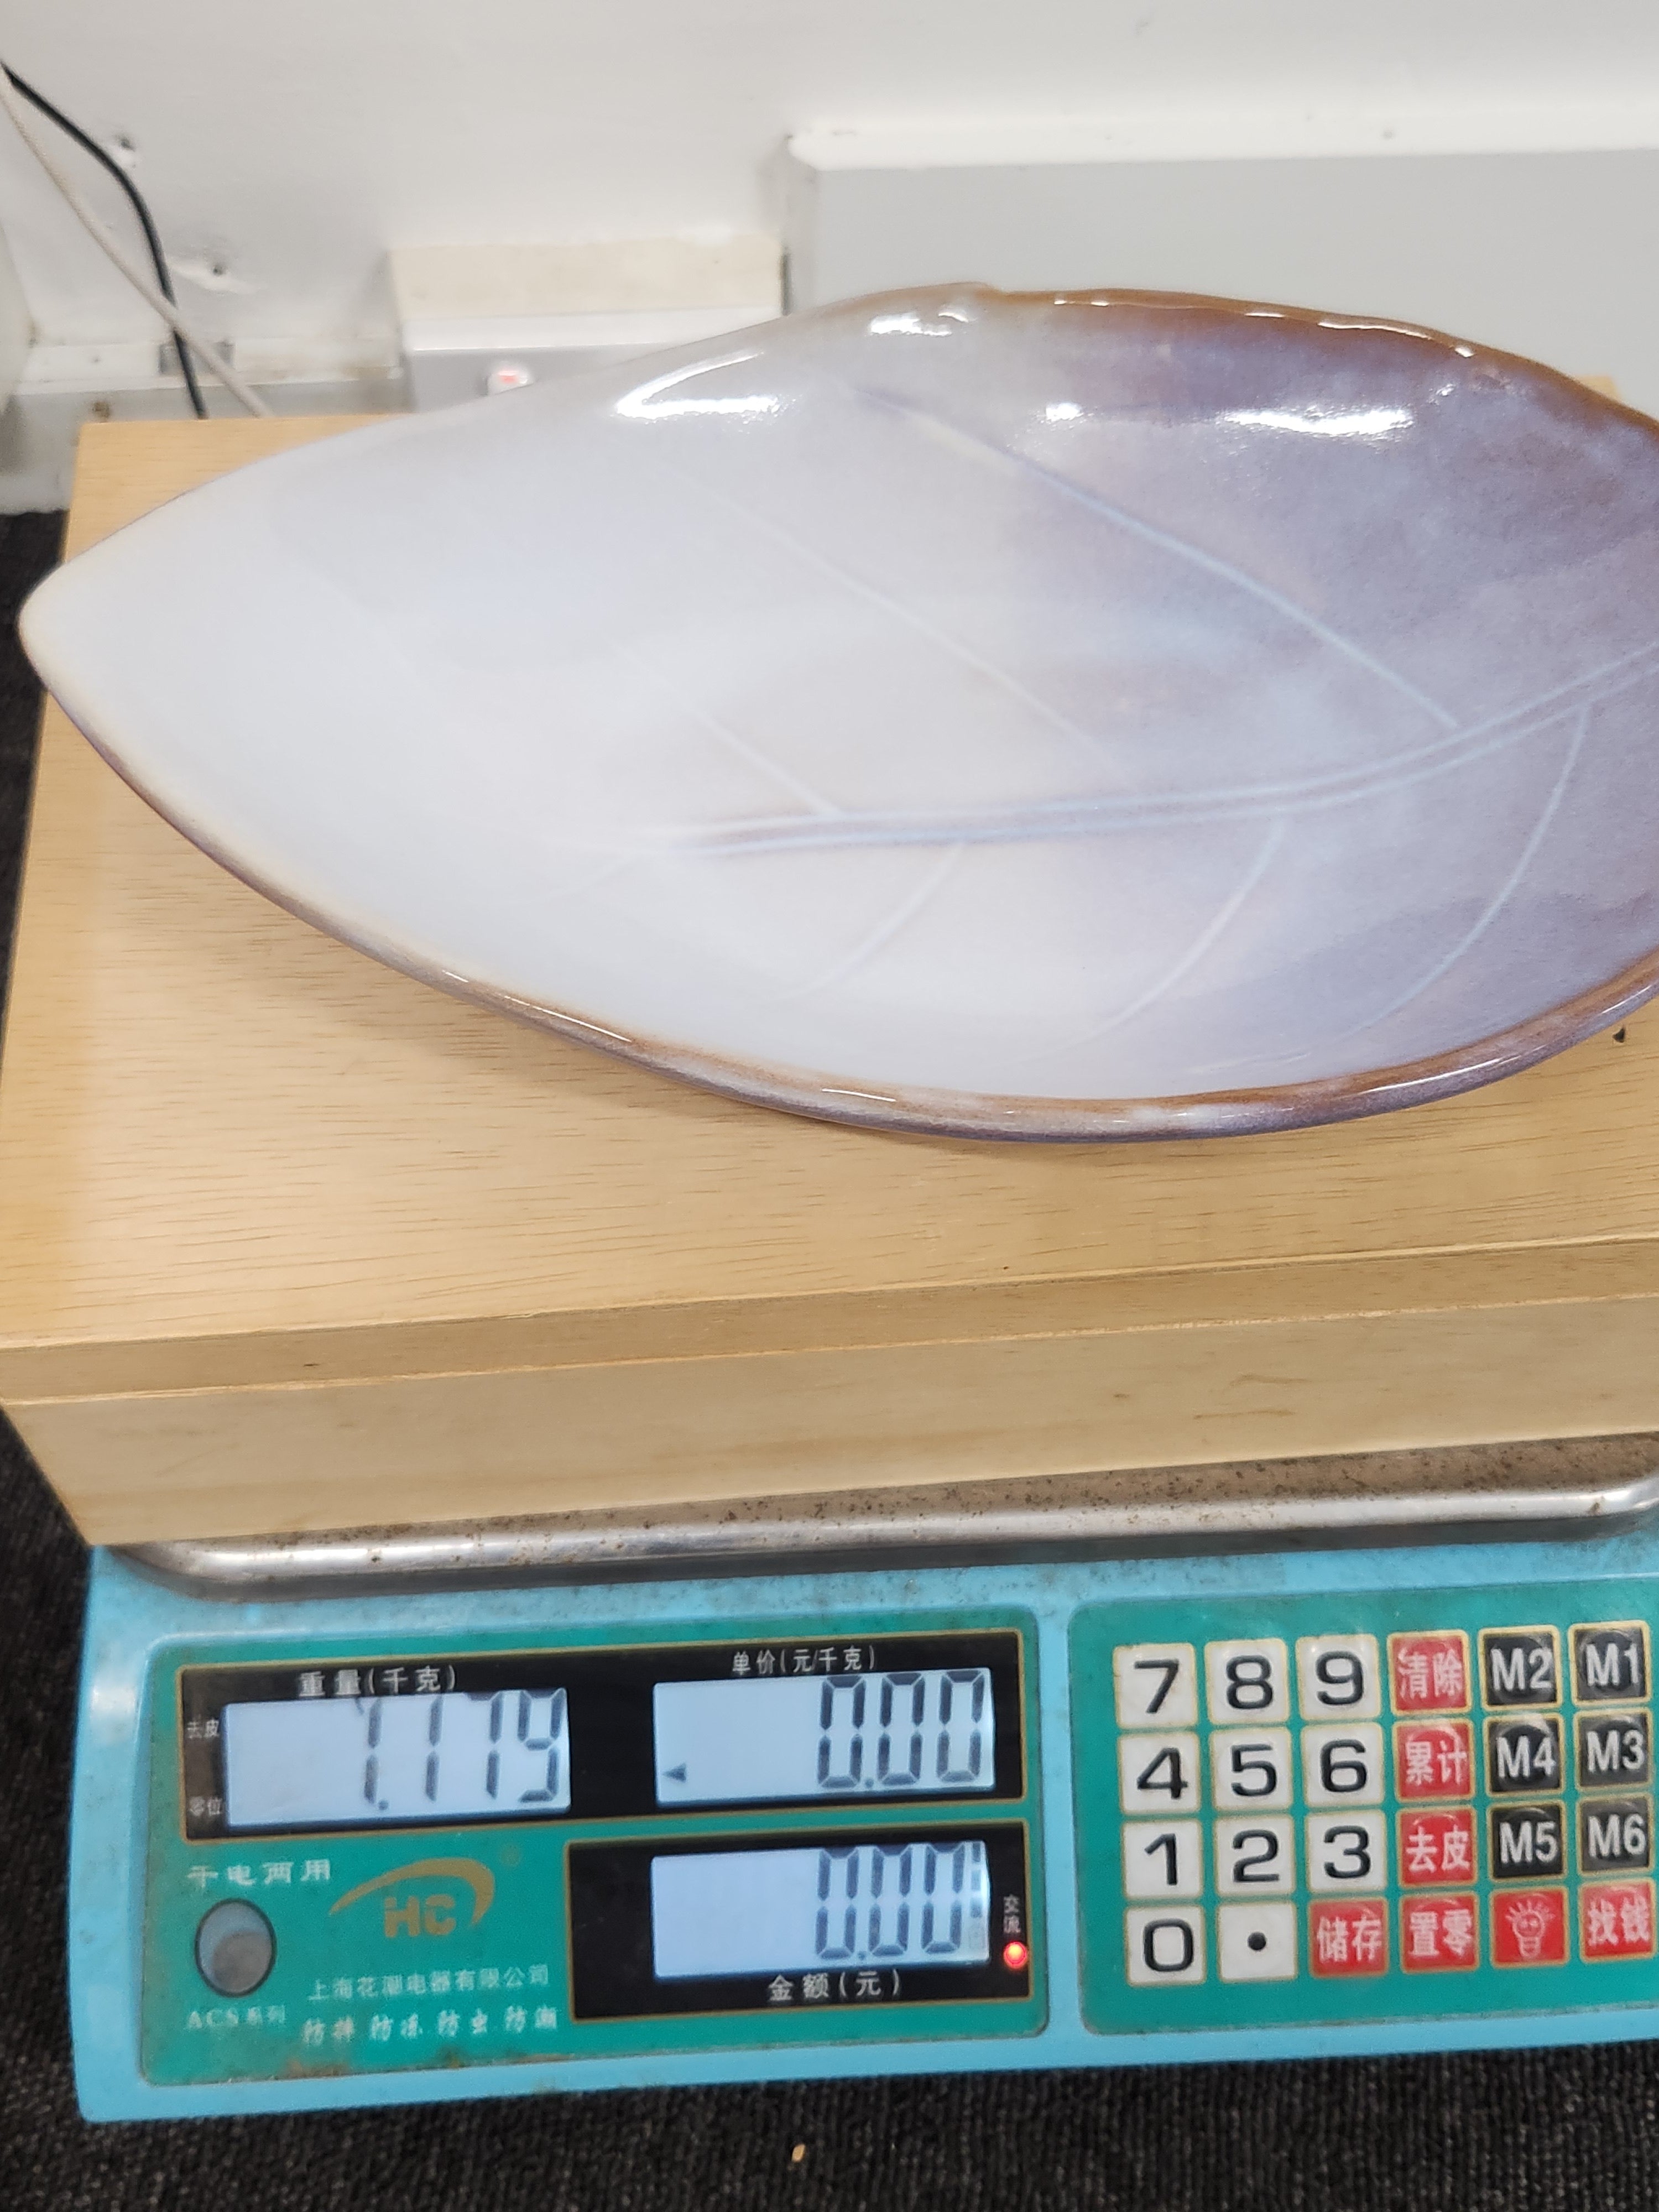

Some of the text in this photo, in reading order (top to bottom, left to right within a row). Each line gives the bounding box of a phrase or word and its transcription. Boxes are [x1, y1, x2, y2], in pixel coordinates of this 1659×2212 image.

[1134, 1658, 1179, 1714] 7
[1226, 1655, 1274, 1710] 8
[1315, 1651, 1365, 1705] 9
[1397, 1647, 1463, 1700] 清除
[1491, 1646, 1553, 1692] M2
[1585, 1642, 1640, 1687] M1
[1137, 1747, 1188, 1800] 4
[1230, 1744, 1277, 1797] 5
[1319, 1739, 1367, 1793] 6
[1405, 1739, 1468, 1786] 累计
[1496, 1734, 1557, 1779] M4
[1587, 1729, 1645, 1772] M3
[1144, 1833, 1178, 1885] 1
[1232, 1829, 1280, 1882] 2
[1323, 1825, 1371, 1879] 3
[1406, 1825, 1471, 1873] 去皮
[1499, 1820, 1559, 1865] M5
[1588, 1813, 1646, 1859] M6
[384, 1894, 456, 1937] HC
[1316, 1916, 1382, 1962] 储存
[1408, 1909, 1473, 1958] 置零
[1142, 1918, 1194, 1973] 0
